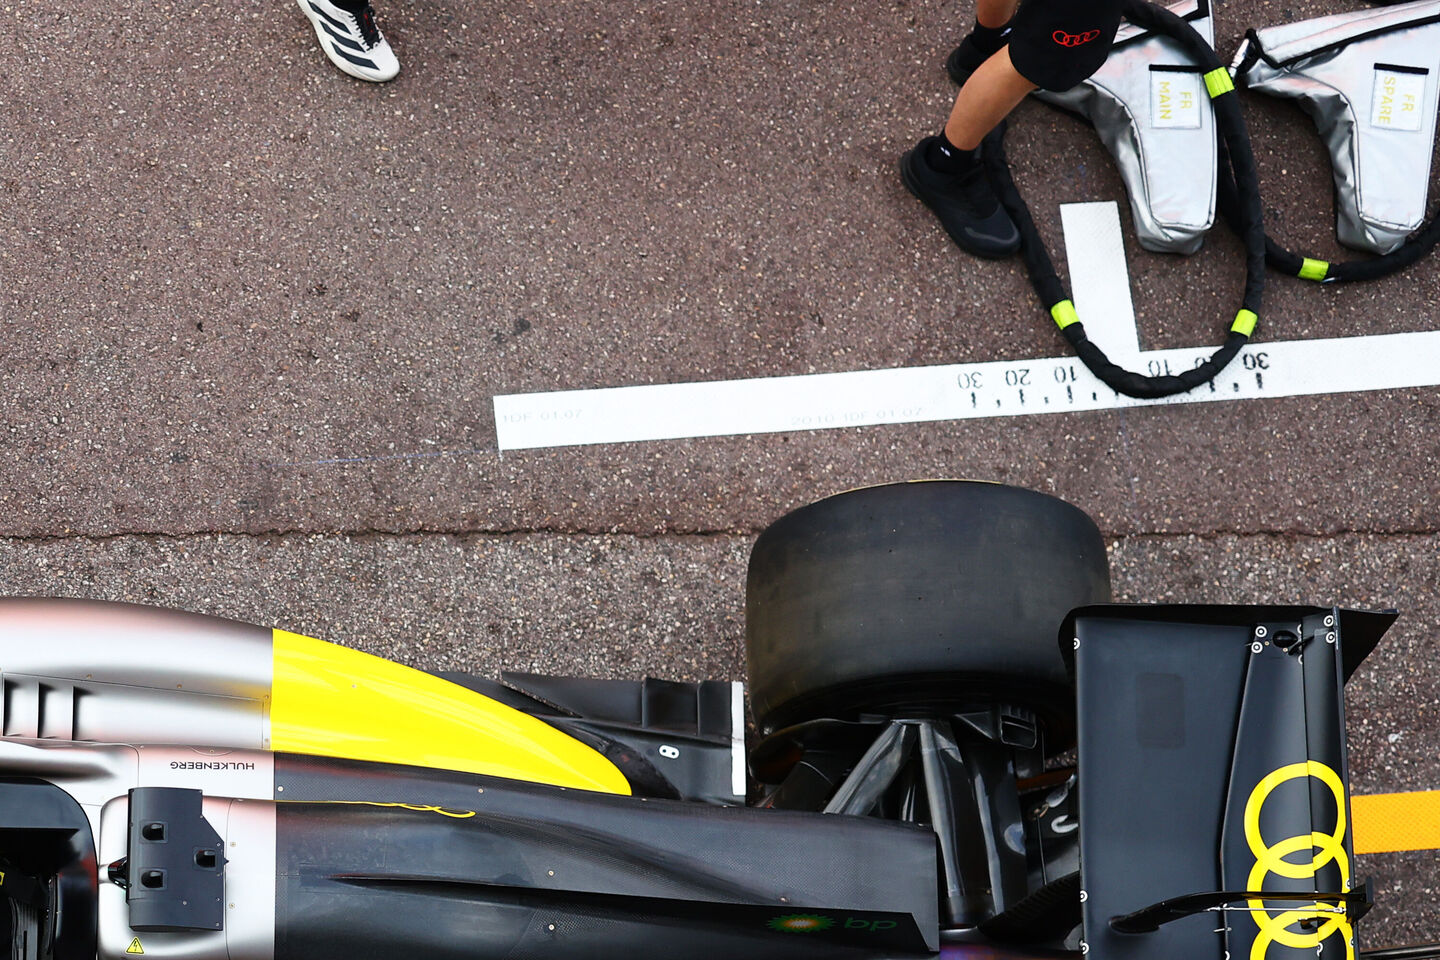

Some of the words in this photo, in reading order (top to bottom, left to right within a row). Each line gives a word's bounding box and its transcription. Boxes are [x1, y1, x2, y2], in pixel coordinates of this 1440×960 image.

[1159, 80, 1172, 120] MAIN
[1178, 91, 1192, 110] FR
[1377, 75, 1396, 125] SPARE
[1401, 93, 1415, 113] FR
[1243, 351, 1270, 371] 30
[957, 371, 983, 390] 30
[1005, 368, 1030, 386] 20
[1054, 365, 1078, 383] 10
[169, 760, 255, 771] HULKENBERG
[844, 917, 898, 933] bp
